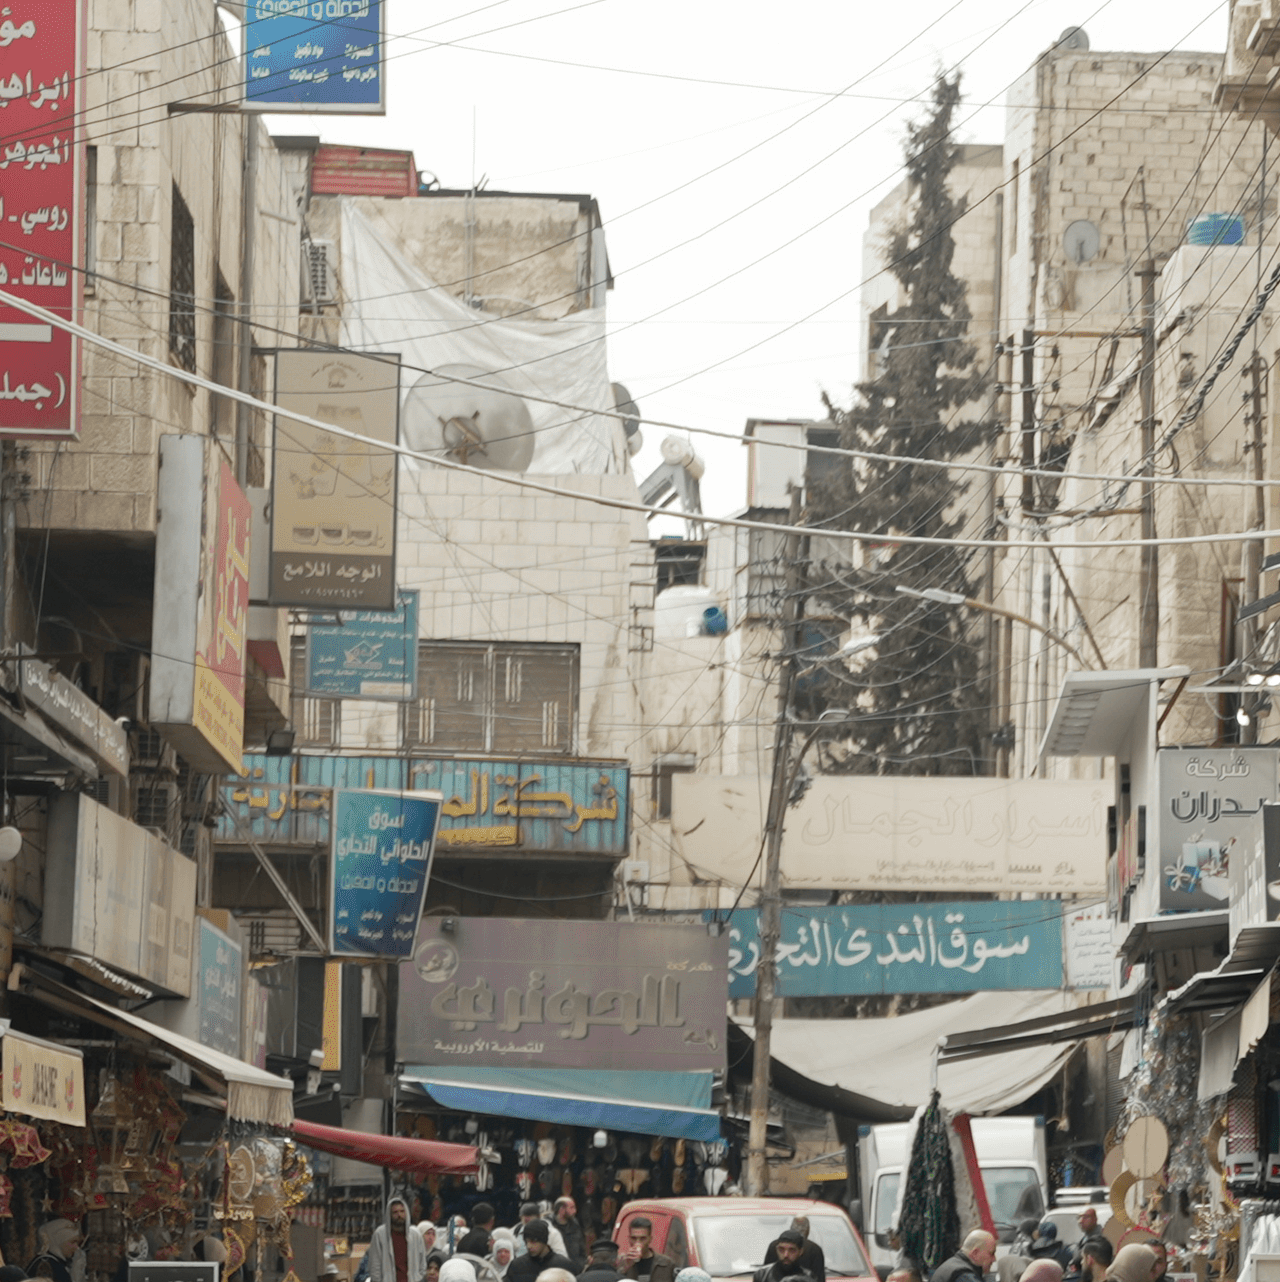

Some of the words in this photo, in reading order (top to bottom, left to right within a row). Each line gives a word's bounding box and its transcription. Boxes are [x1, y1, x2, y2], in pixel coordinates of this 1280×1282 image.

[20, 205, 69, 235] روسي
[21, 256, 68, 287] ساعات
[282, 560, 331, 582] اللامع
[336, 562, 382, 583] الوجه
[1185, 757, 1251, 782] شركة
[368, 804, 406, 830] سوق
[937, 911, 1031, 974] سوق
